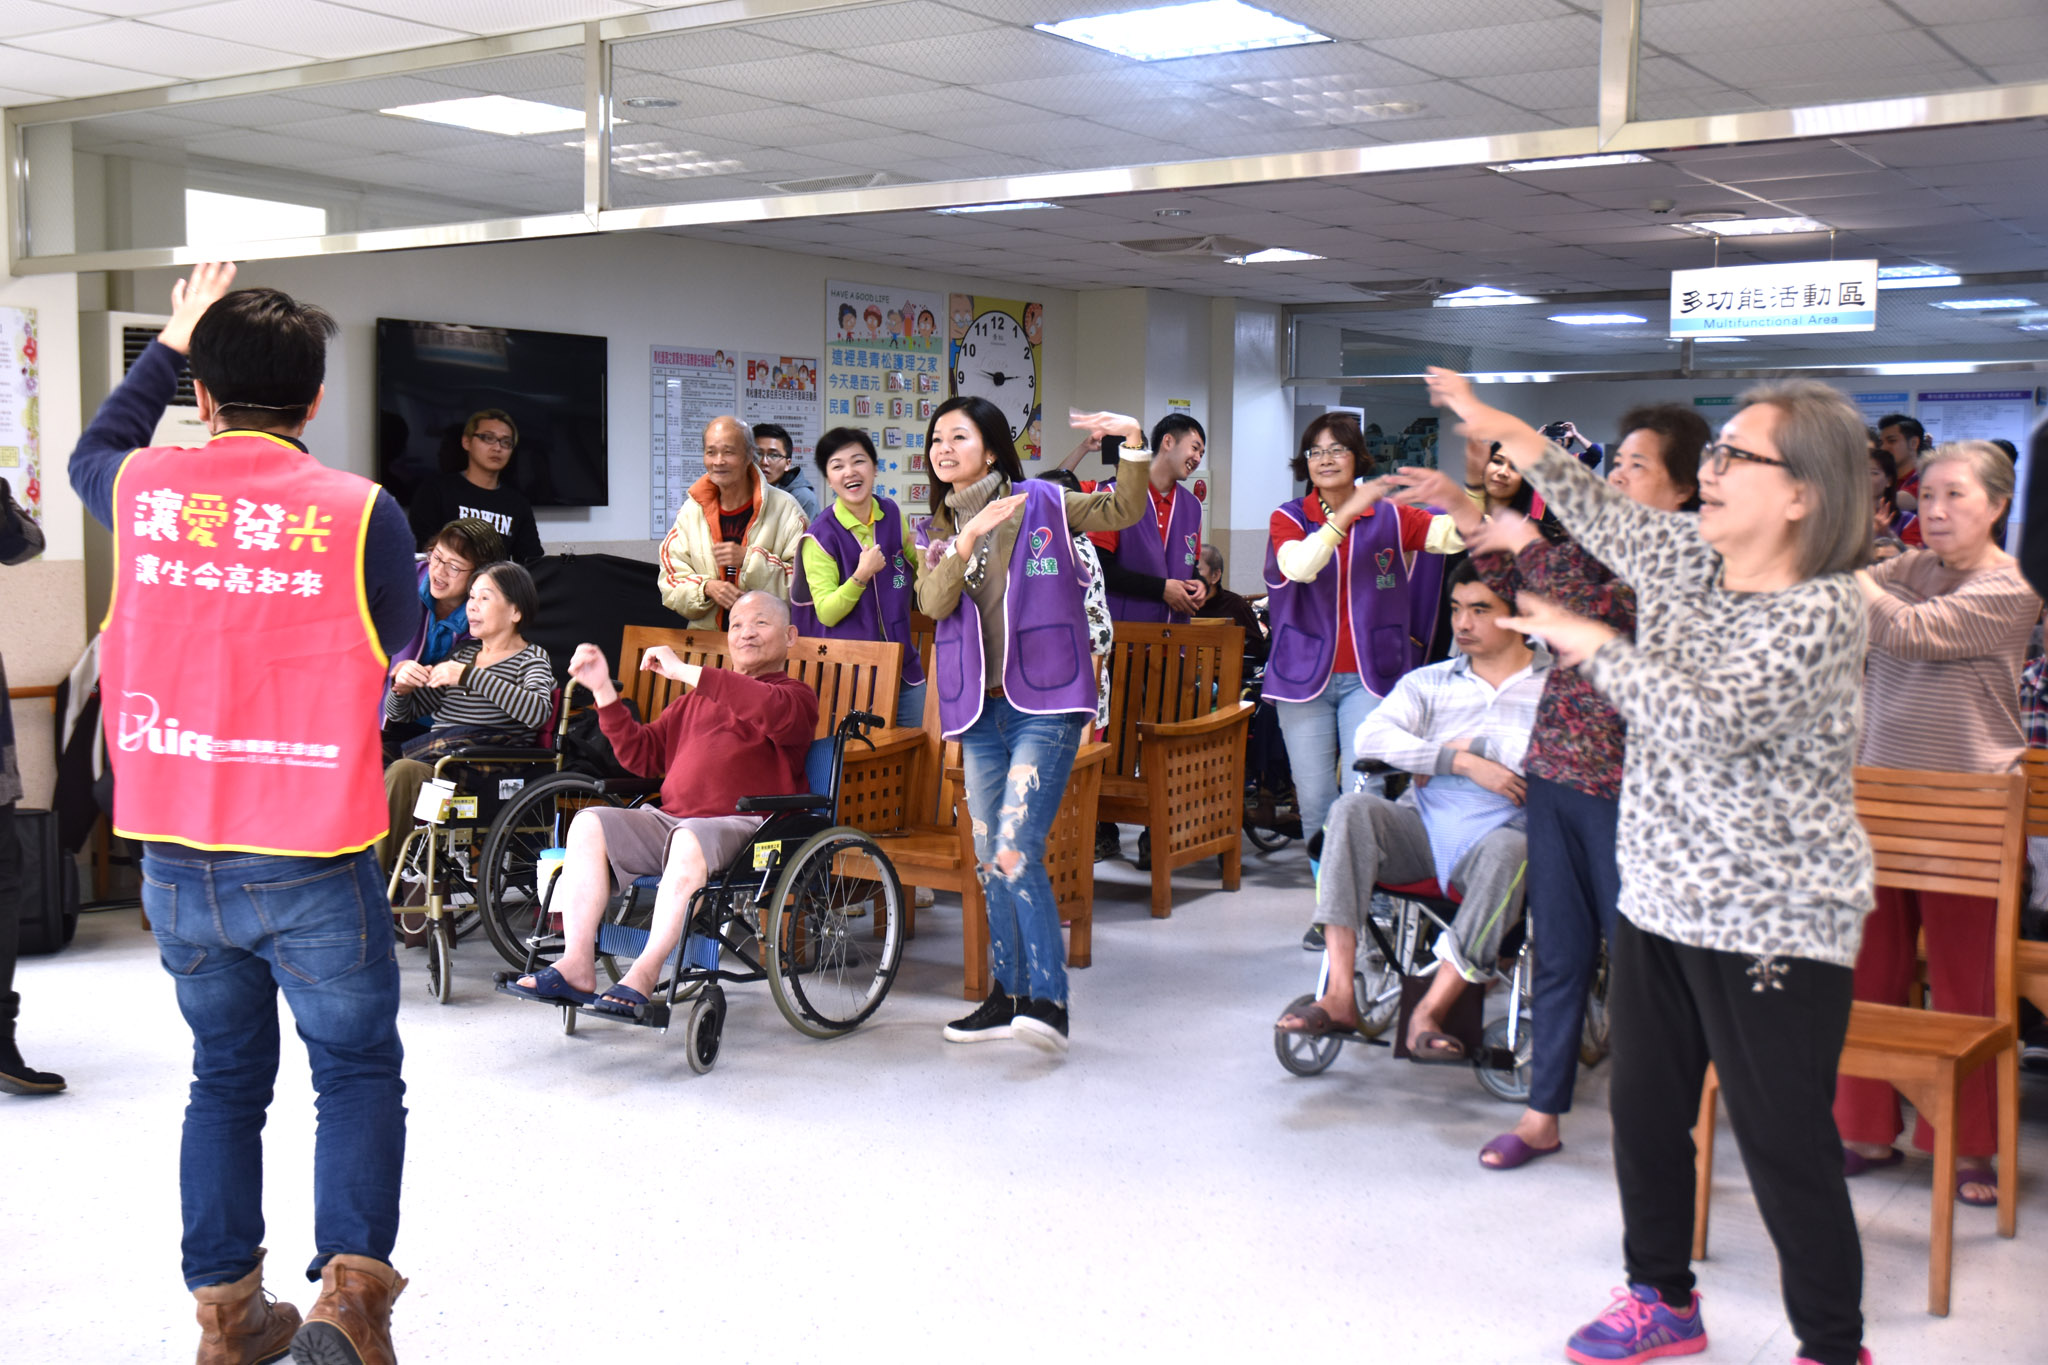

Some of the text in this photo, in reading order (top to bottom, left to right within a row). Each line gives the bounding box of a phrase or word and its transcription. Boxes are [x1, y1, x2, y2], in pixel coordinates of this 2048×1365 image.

[831, 289, 848, 299] HAVE
[856, 293, 874, 302] GOOD
[875, 295, 890, 304] LIFE
[1680, 281, 1866, 314] 多功能活動區
[975, 322, 988, 337] 11
[991, 316, 1004, 330] 12
[1703, 315, 1838, 329] Multifunctional Area
[1012, 325, 1018, 338] 1
[962, 343, 976, 357] 10
[1024, 347, 1031, 360] 2
[832, 348, 938, 373] 這裡是青松護理之家
[829, 373, 880, 392] 今天是西元
[958, 371, 965, 385] 9
[1028, 375, 1034, 388] 3
[829, 399, 849, 414] 民國
[858, 401, 870, 414] 107
[875, 402, 884, 416] 年
[895, 402, 902, 415] 3
[904, 403, 913, 418] 月
[923, 404, 930, 416] 8
[1023, 403, 1029, 416] 4
[1010, 426, 1017, 439] 5
[905, 433, 924, 448] 星期
[134, 488, 332, 553] 讓愛發光
[458, 505, 513, 536] EDWIN
[1026, 557, 1059, 577] 永達
[135, 553, 323, 598] 讓生命亮起來
